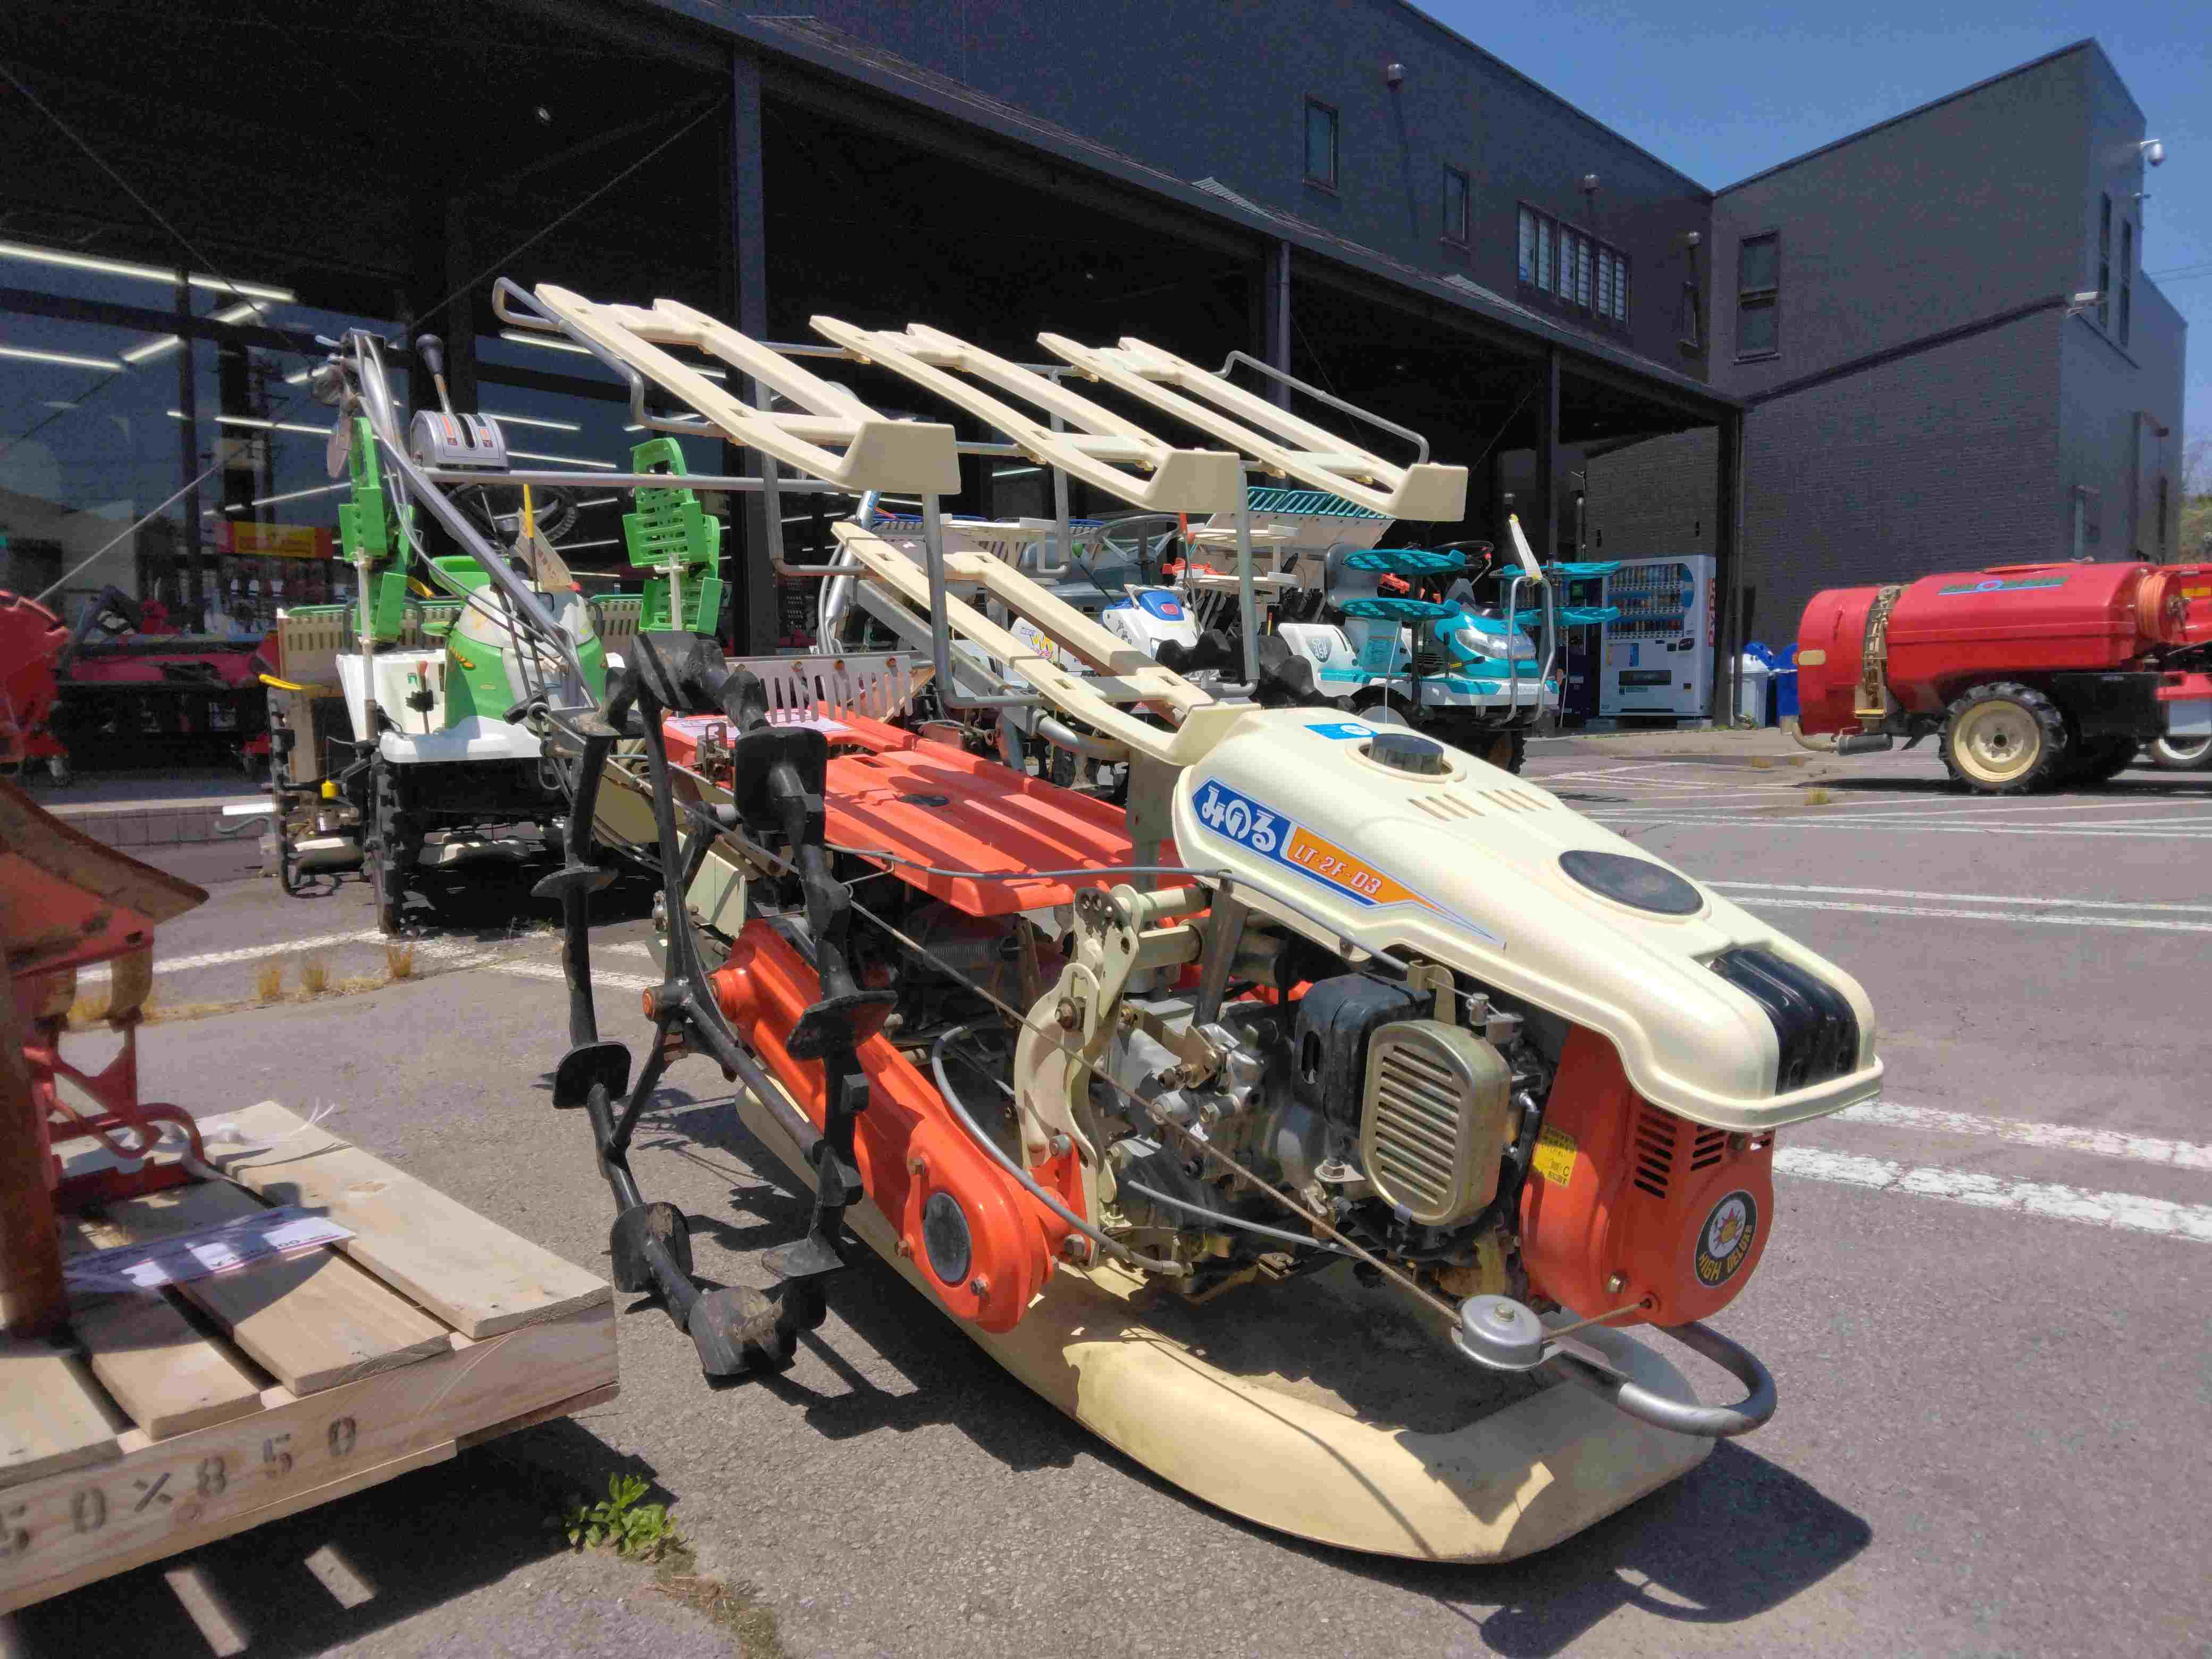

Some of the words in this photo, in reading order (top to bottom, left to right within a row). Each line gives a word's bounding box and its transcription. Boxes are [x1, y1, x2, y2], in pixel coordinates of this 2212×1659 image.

[1202, 785, 1277, 852] みのる
[1699, 1252, 1723, 1281] HIGH
